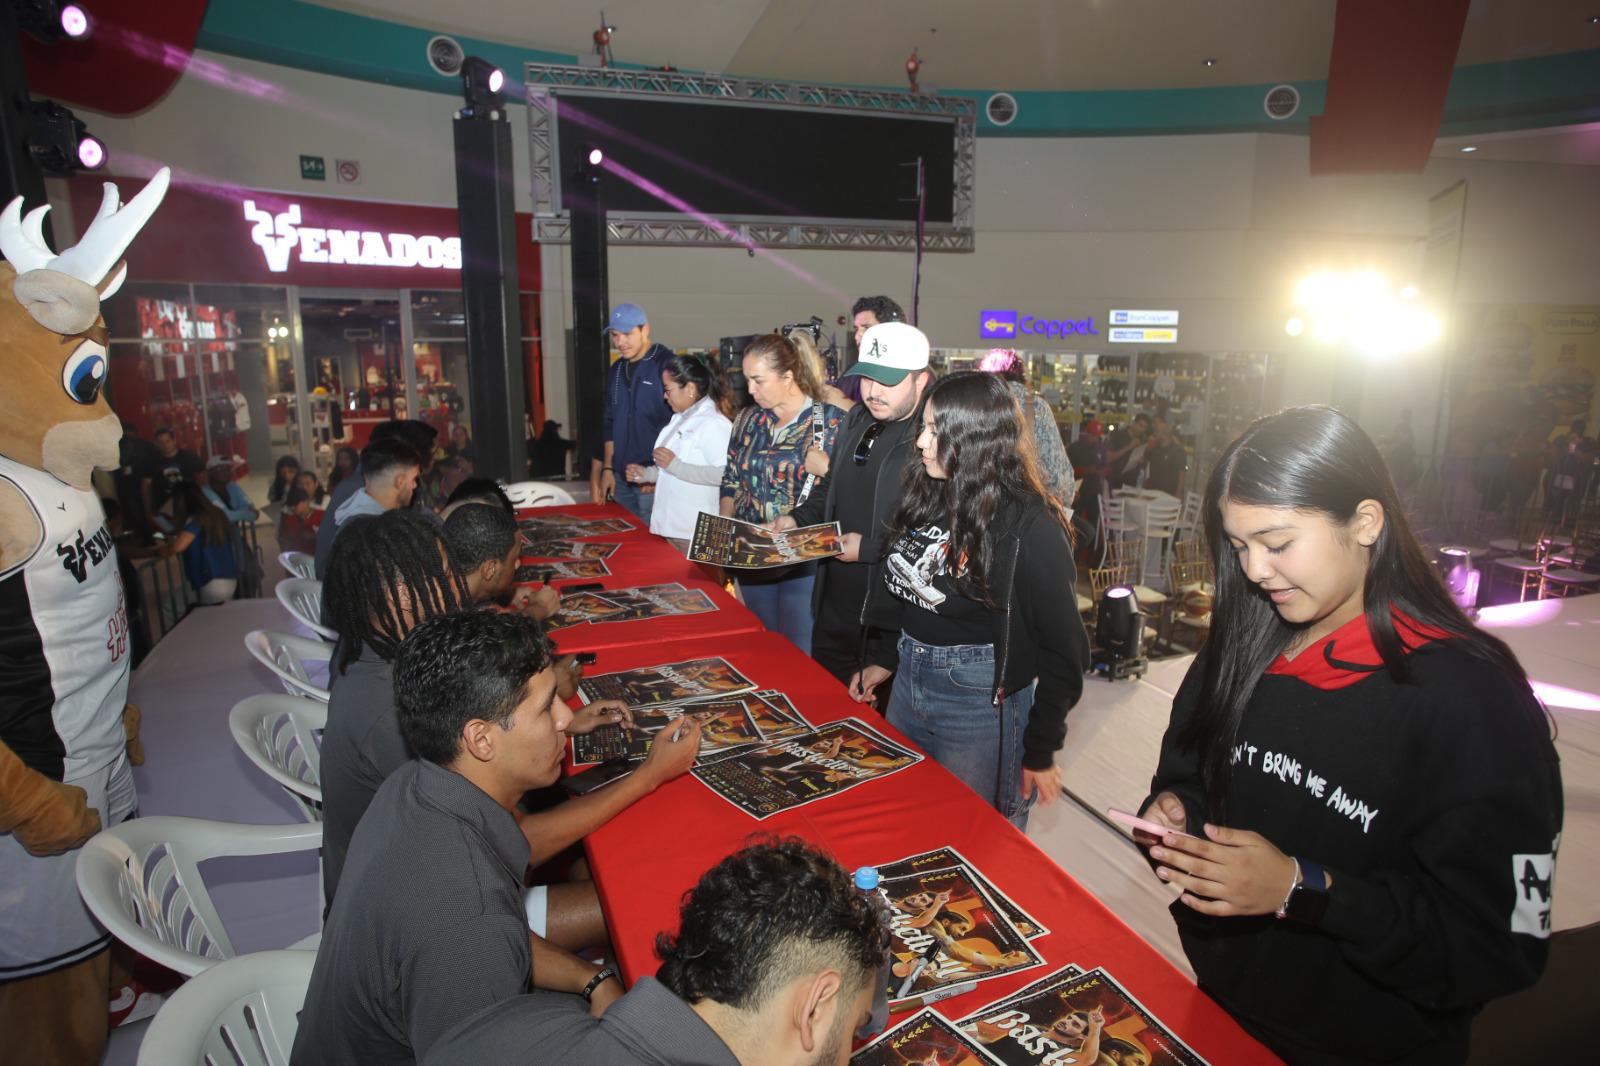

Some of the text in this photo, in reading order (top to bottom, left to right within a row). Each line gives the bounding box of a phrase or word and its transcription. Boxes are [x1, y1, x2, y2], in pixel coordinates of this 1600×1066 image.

[243, 200, 463, 272] VENADOS
[1019, 315, 1100, 340] Coppel
[1230, 741, 1379, 834] N'T BRING ME AWAY
